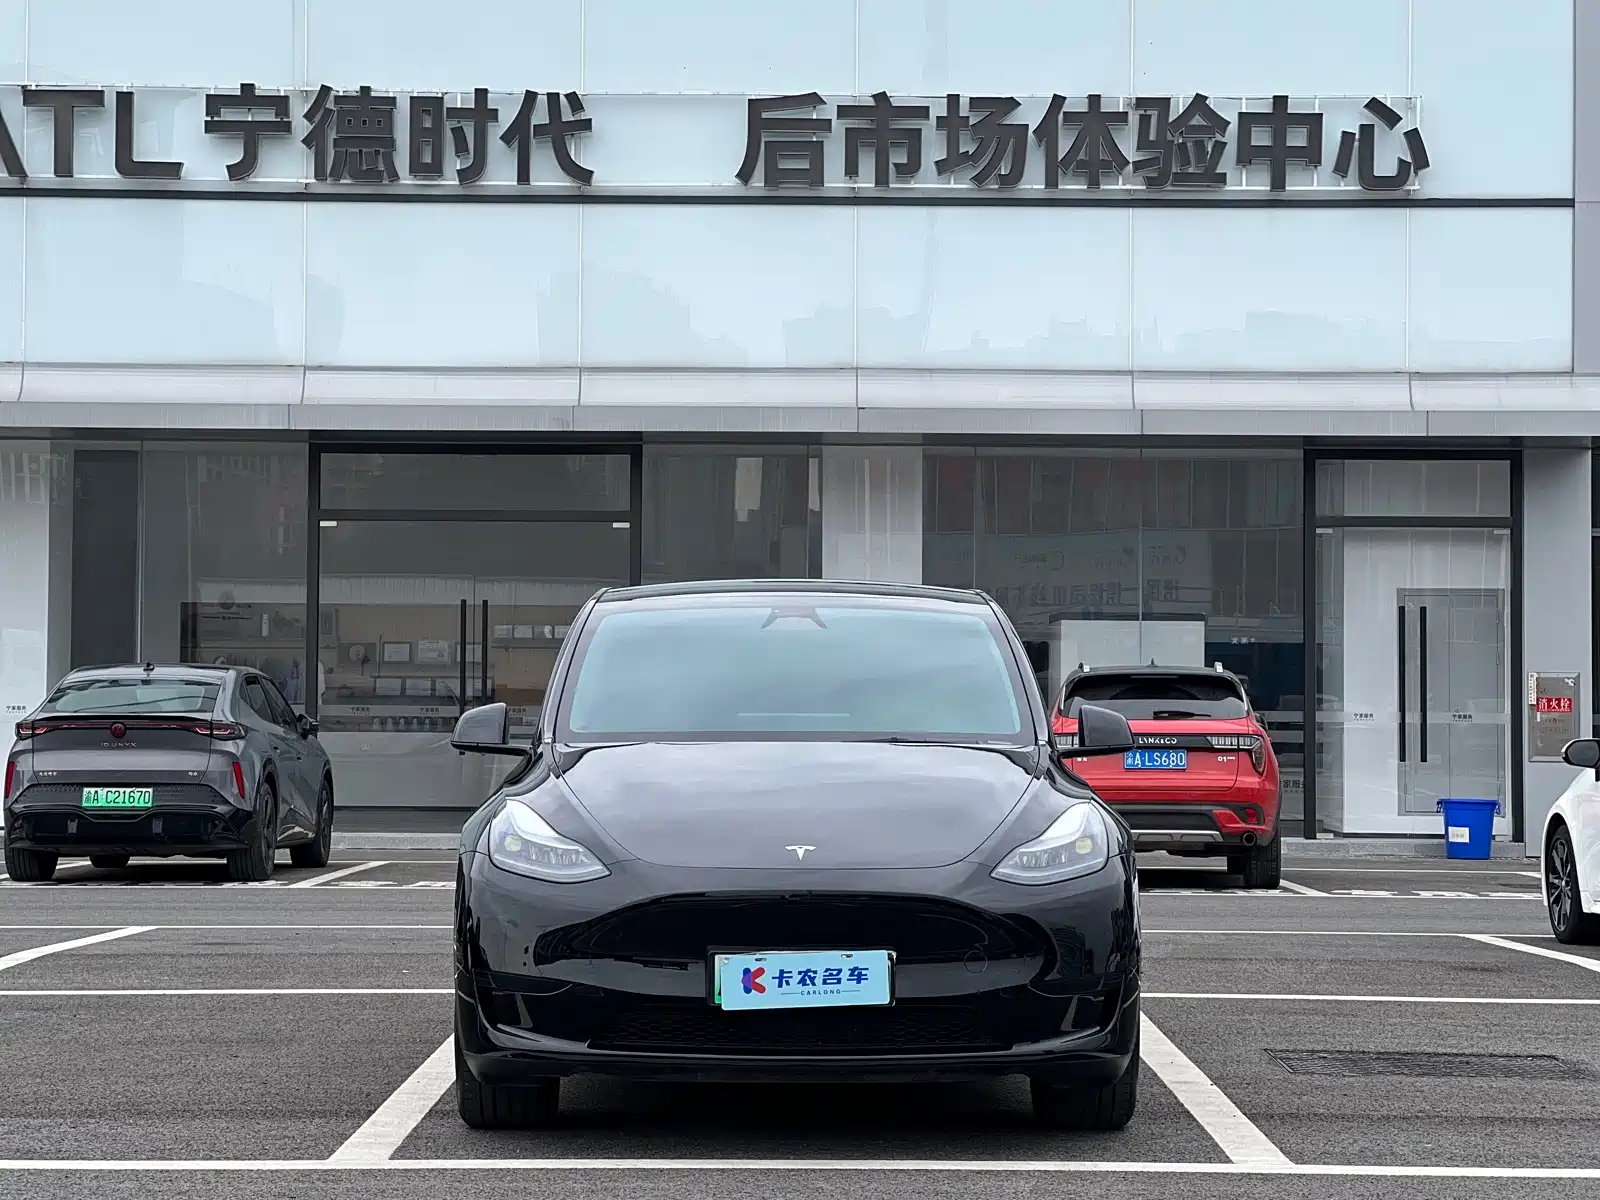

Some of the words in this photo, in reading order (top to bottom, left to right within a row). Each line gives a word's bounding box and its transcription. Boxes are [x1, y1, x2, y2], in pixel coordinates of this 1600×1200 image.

[204, 83, 594, 187] 宁德时代
[735, 91, 1431, 192] 后市场体验中心
[1537, 697, 1571, 710] 消火栓
[105, 790, 151, 804] C21670
[771, 966, 869, 988] 卡农名车
[800, 988, 841, 996] CARLONG
